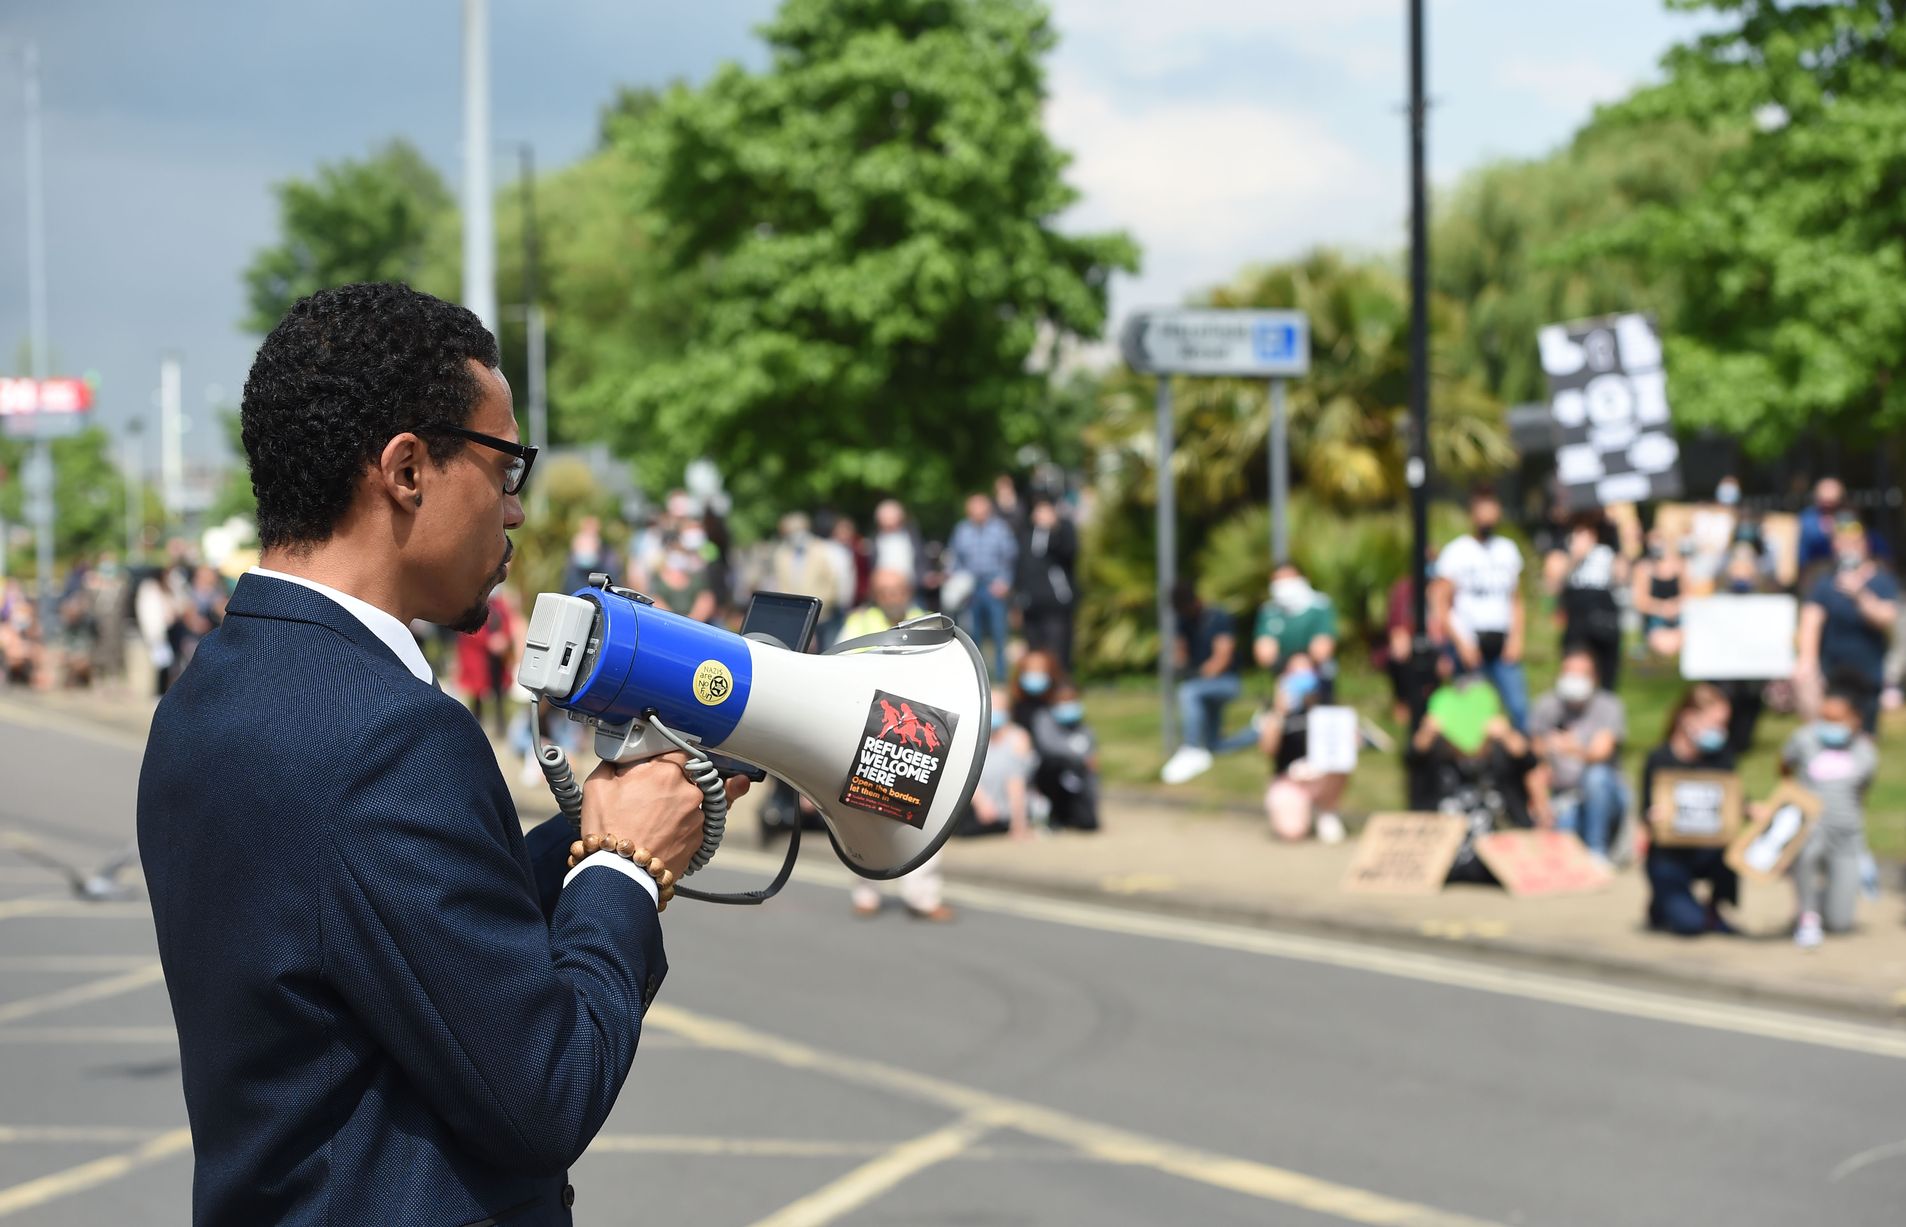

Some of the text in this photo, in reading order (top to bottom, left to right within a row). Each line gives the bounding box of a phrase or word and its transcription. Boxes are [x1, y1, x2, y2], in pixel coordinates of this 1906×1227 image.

[700, 672, 712, 680] are
[864, 736, 939, 771] REFUGEES
[855, 764, 896, 787] HERE
[860, 750, 931, 784] WELCOME
[849, 784, 860, 792] let
[861, 787, 880, 799] them
[852, 776, 873, 788] Open
[875, 785, 888, 794] the
